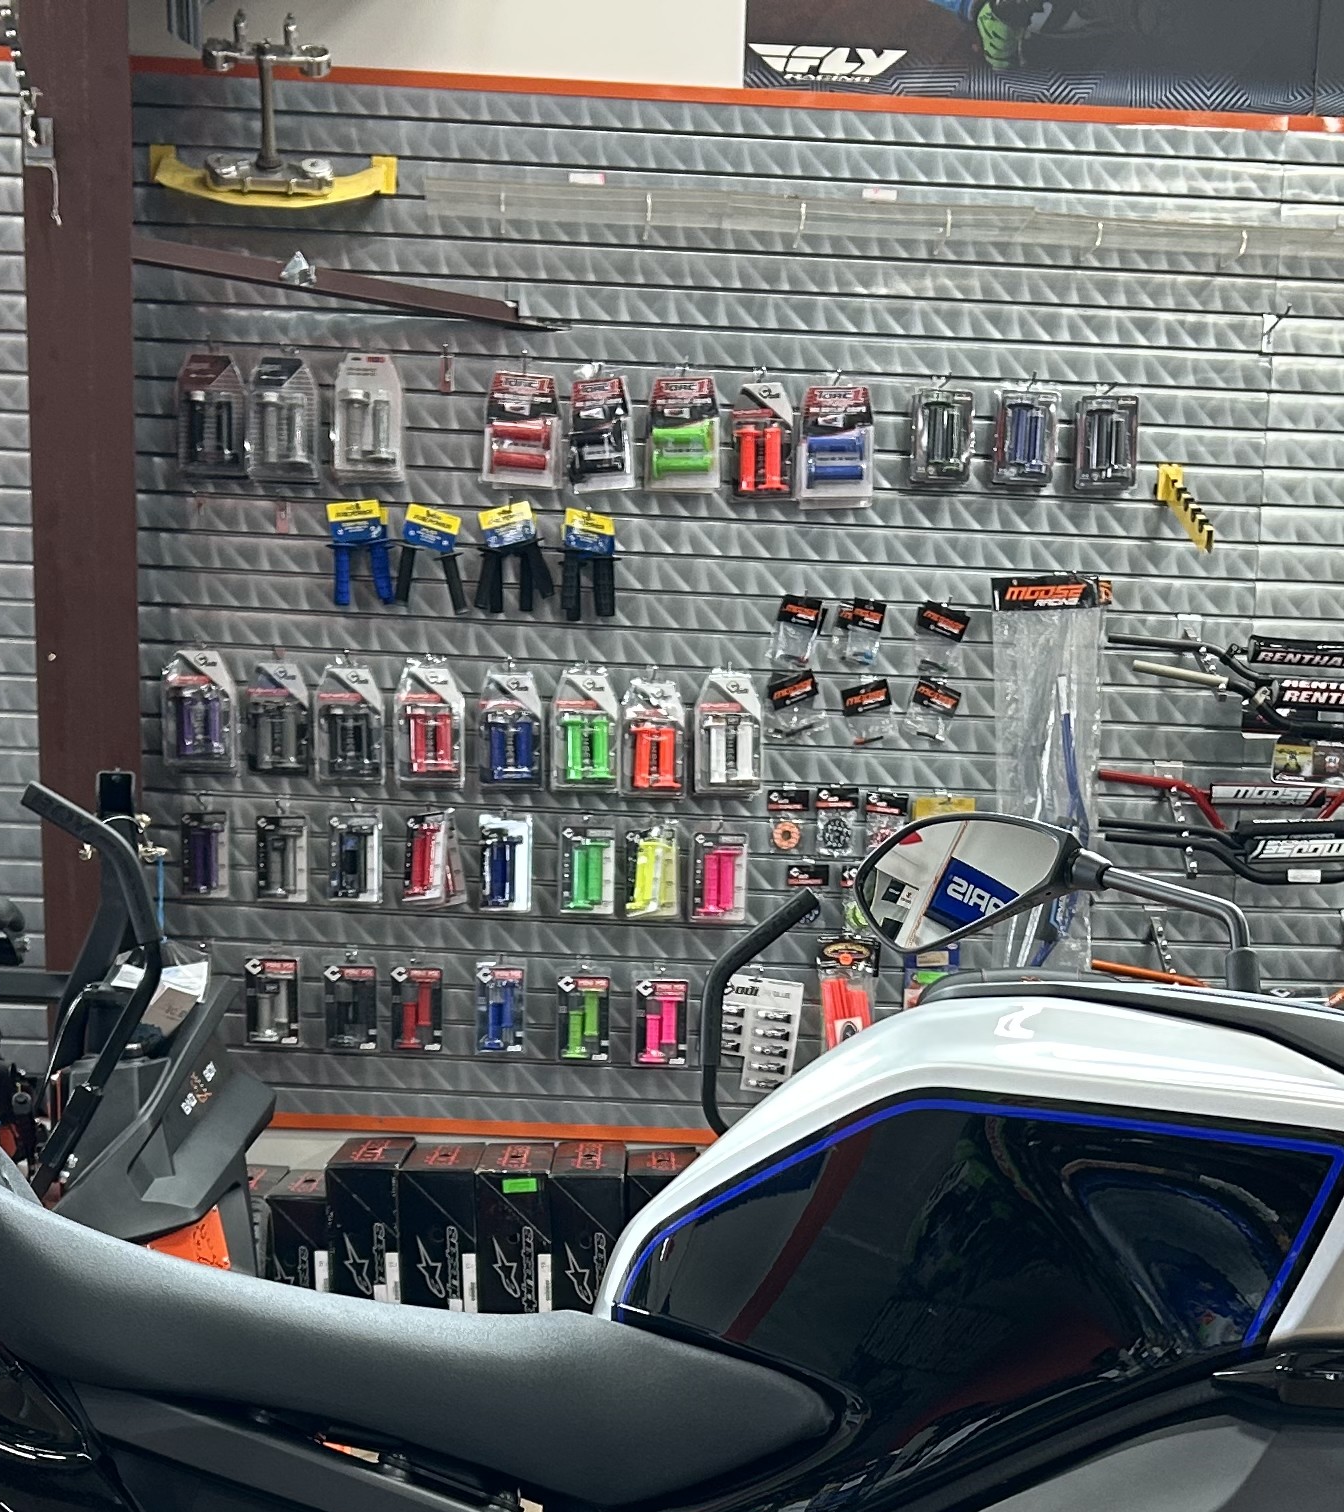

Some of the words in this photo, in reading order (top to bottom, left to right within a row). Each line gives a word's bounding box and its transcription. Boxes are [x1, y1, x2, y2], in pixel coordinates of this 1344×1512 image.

[766, 43, 907, 76] FLY
[1006, 584, 1088, 600] MOOSE
[1233, 788, 1313, 802] MOOSE
[1261, 843, 1343, 858] MOOSE
